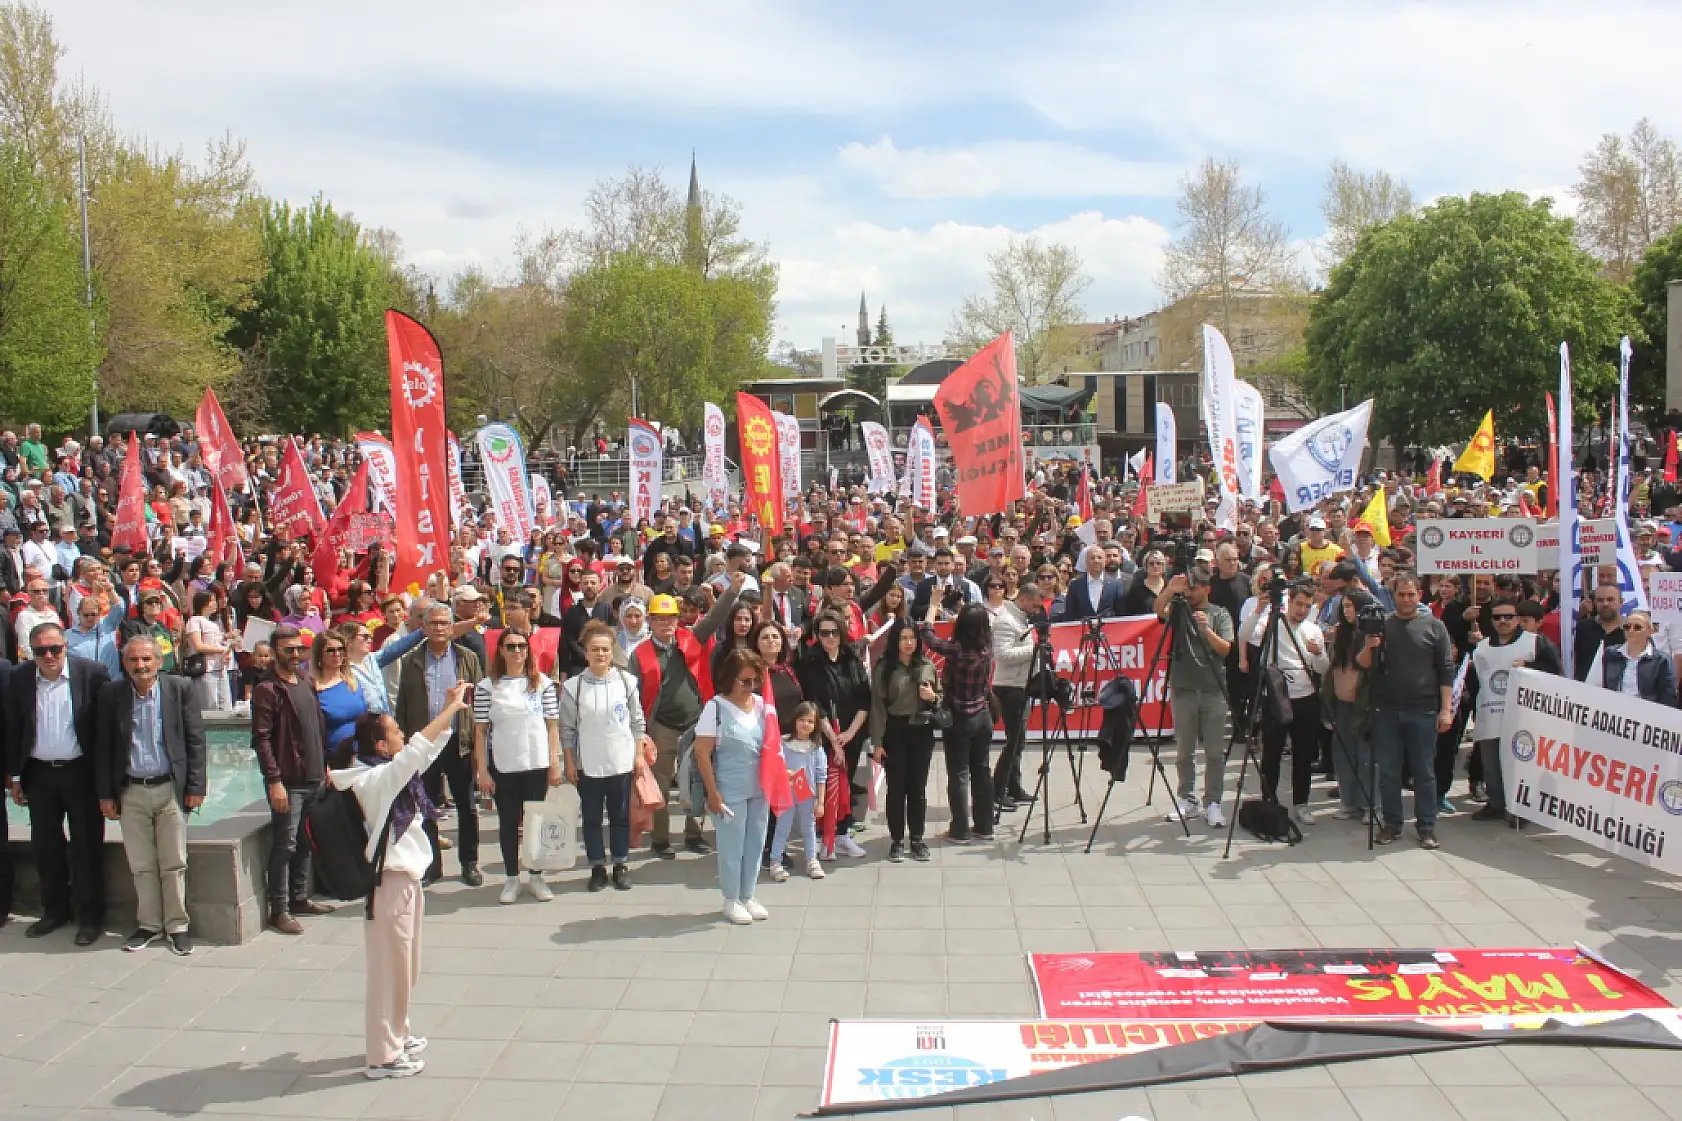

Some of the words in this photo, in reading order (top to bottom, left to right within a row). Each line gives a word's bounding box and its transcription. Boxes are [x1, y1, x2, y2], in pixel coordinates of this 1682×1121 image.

[1449, 528, 1505, 540] KAYSERİ
[1470, 544, 1483, 555] İL
[1434, 557, 1521, 570] TEMSİLCİLİĞİ
[1516, 686, 1590, 726] EMEKLİLİKTE
[1590, 708, 1640, 741] ADALET
[1642, 723, 1682, 755] DERN
[1536, 735, 1660, 806] KAYSERİ
[1515, 779, 1531, 808] İL
[1537, 790, 1665, 858] TEMSİLCİLİĞİ
[1345, 971, 1571, 1002] MAYIS
[857, 1068, 1008, 1086] KESK
